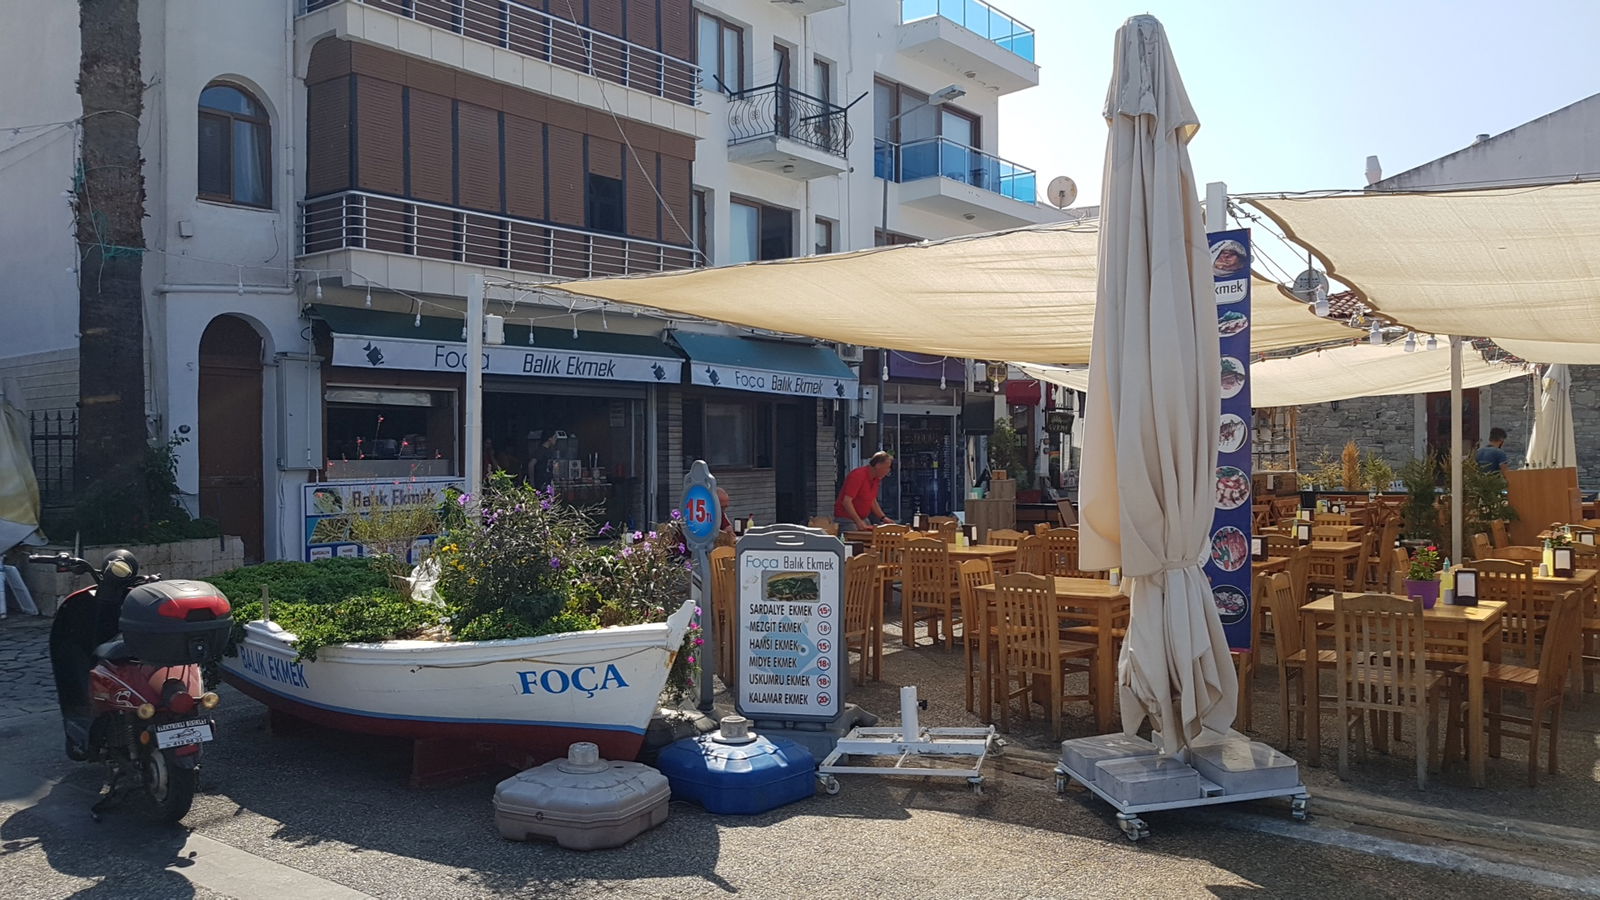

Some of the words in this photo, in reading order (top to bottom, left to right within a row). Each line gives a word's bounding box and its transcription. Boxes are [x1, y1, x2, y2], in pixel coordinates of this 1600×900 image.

[1214, 280, 1244, 295] kmek
[523, 353, 561, 375] Balık
[567, 355, 616, 378] Ekmek
[771, 375, 793, 392] Balık
[795, 377, 824, 395] Ekmek
[745, 555, 779, 570] Foça
[783, 555, 804, 569] Balık
[807, 556, 834, 571] Ekmek
[749, 603, 785, 616] SARDALYE
[788, 605, 813, 617] EKMEK
[778, 621, 802, 633] EKMEK
[775, 639, 799, 651] EKMEK
[239, 645, 268, 679] BALIK
[267, 655, 310, 689] EKMEK
[773, 656, 797, 669] EKMEK
[516, 663, 630, 699] FOÇA
[748, 673, 785, 686] USKUMRU
[786, 675, 811, 687] EKMEK
[748, 692, 783, 704] KALAMAR
[784, 693, 809, 705] EKMEK
